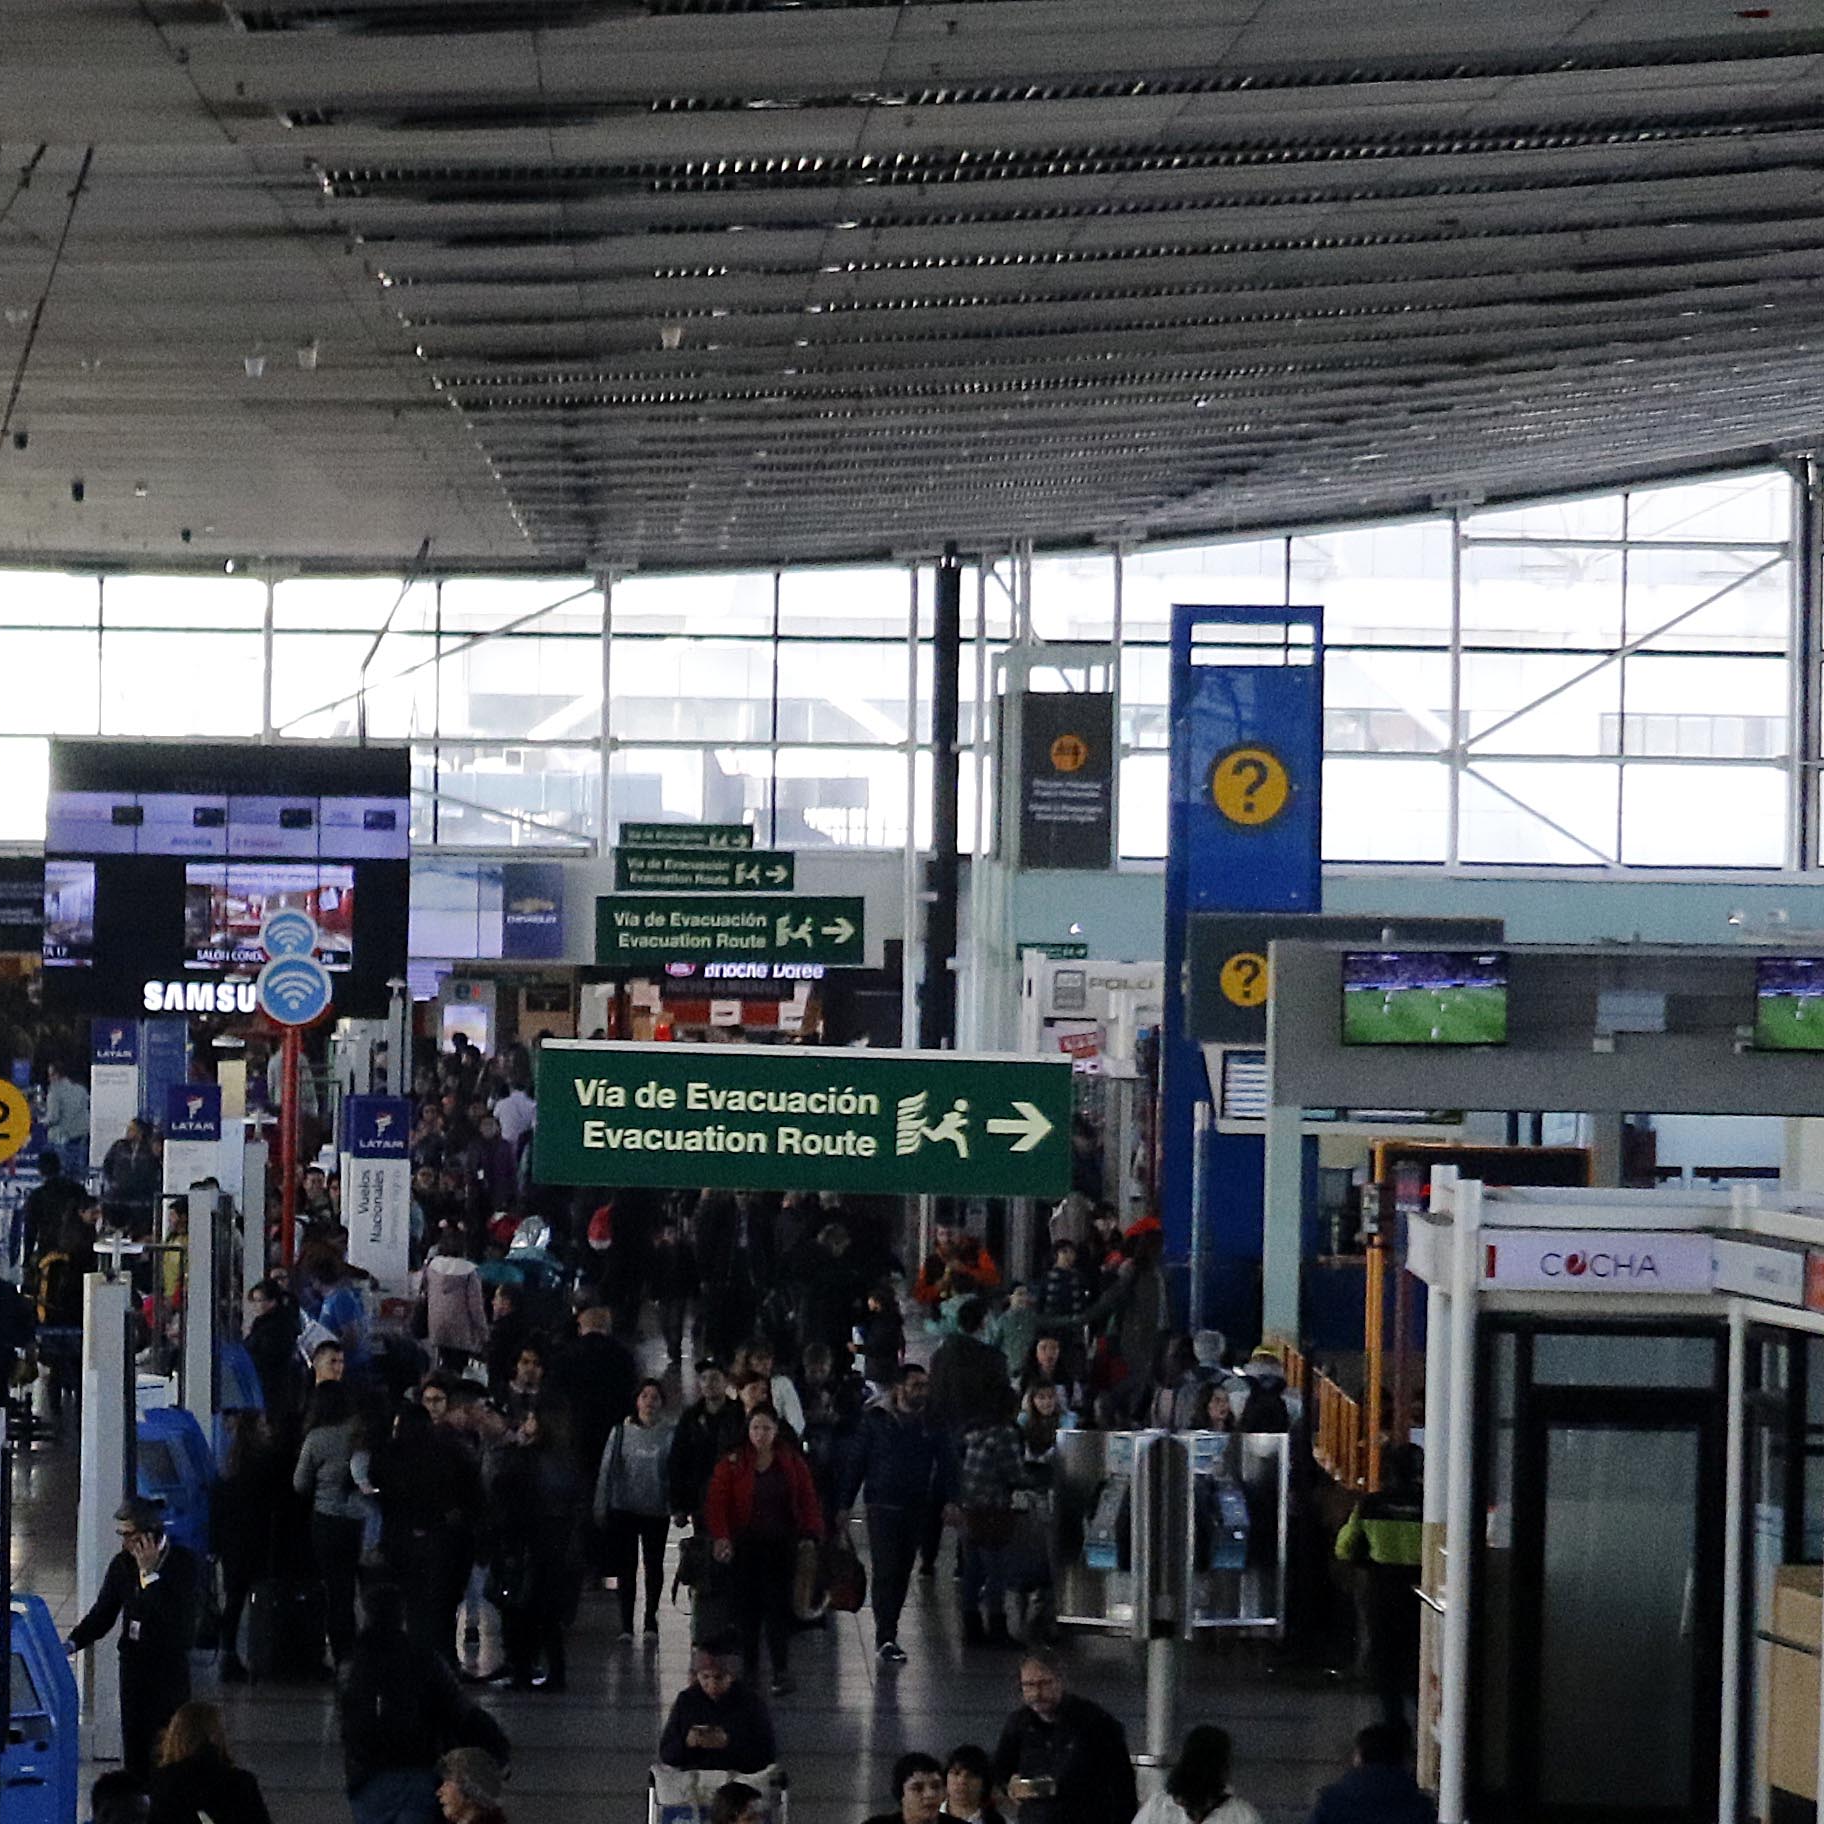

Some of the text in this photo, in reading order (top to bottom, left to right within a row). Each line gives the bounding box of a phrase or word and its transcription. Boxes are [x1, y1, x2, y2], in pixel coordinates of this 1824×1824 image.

[614, 912, 767, 928] Vía de Evacuación
[618, 933, 766, 949] Evacuation Route
[142, 979, 258, 1013] SAMSU
[574, 1078, 880, 1116] Vía de Evacuación
[359, 1138, 404, 1149] LATAM
[582, 1120, 878, 1157] Evacuation Route
